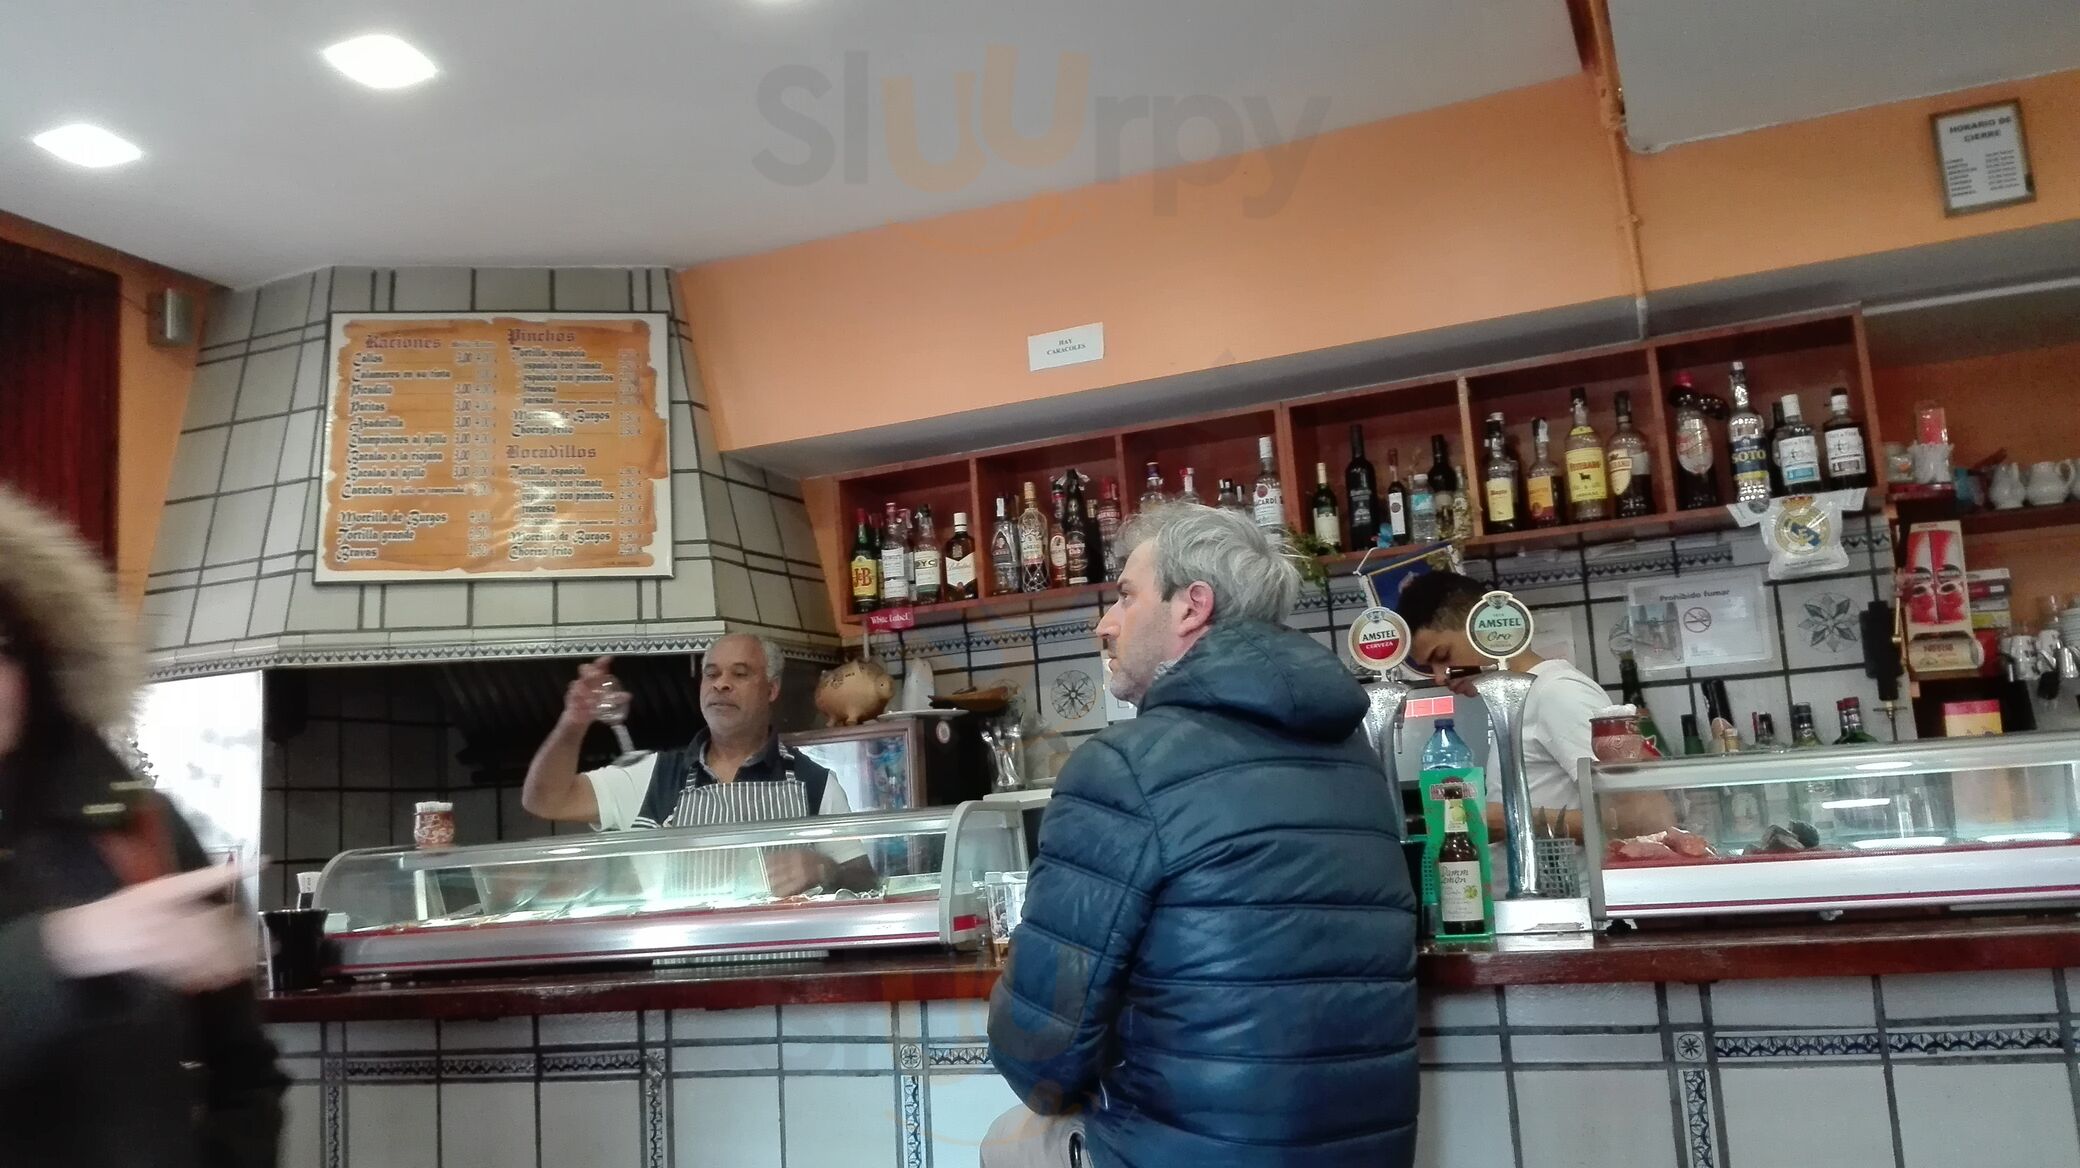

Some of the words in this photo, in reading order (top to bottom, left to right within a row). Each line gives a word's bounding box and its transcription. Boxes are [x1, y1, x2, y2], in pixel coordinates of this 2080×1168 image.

[1949, 119, 1996, 133] HORARIO
[1964, 130, 2001, 141] CIERRE
[365, 335, 442, 349] Raciones
[507, 328, 575, 345] Pinchos
[1058, 338, 1072, 346] HAY
[1046, 344, 1086, 356] CARACOLES
[505, 444, 597, 458] Bocadillos
[1731, 449, 1766, 463] SOTO
[342, 484, 393, 498] Caracoles
[392, 511, 403, 522] de
[406, 510, 447, 525] Burgos
[338, 528, 378, 542] Tortilla
[382, 528, 414, 542] grande
[573, 530, 611, 544] Burgos
[336, 546, 377, 560] Bravas
[509, 546, 548, 559] Chorizo
[552, 546, 573, 556] frito
[1659, 591, 1702, 602] Prohibido
[1704, 589, 1730, 597] fumar
[870, 615, 888, 625] White
[889, 612, 909, 623] Label
[1478, 617, 1521, 629] AMSTEL
[1361, 629, 1397, 642] AMSTEL
[1487, 631, 1512, 641] Oro
[1365, 640, 1394, 650] CERVEZA
